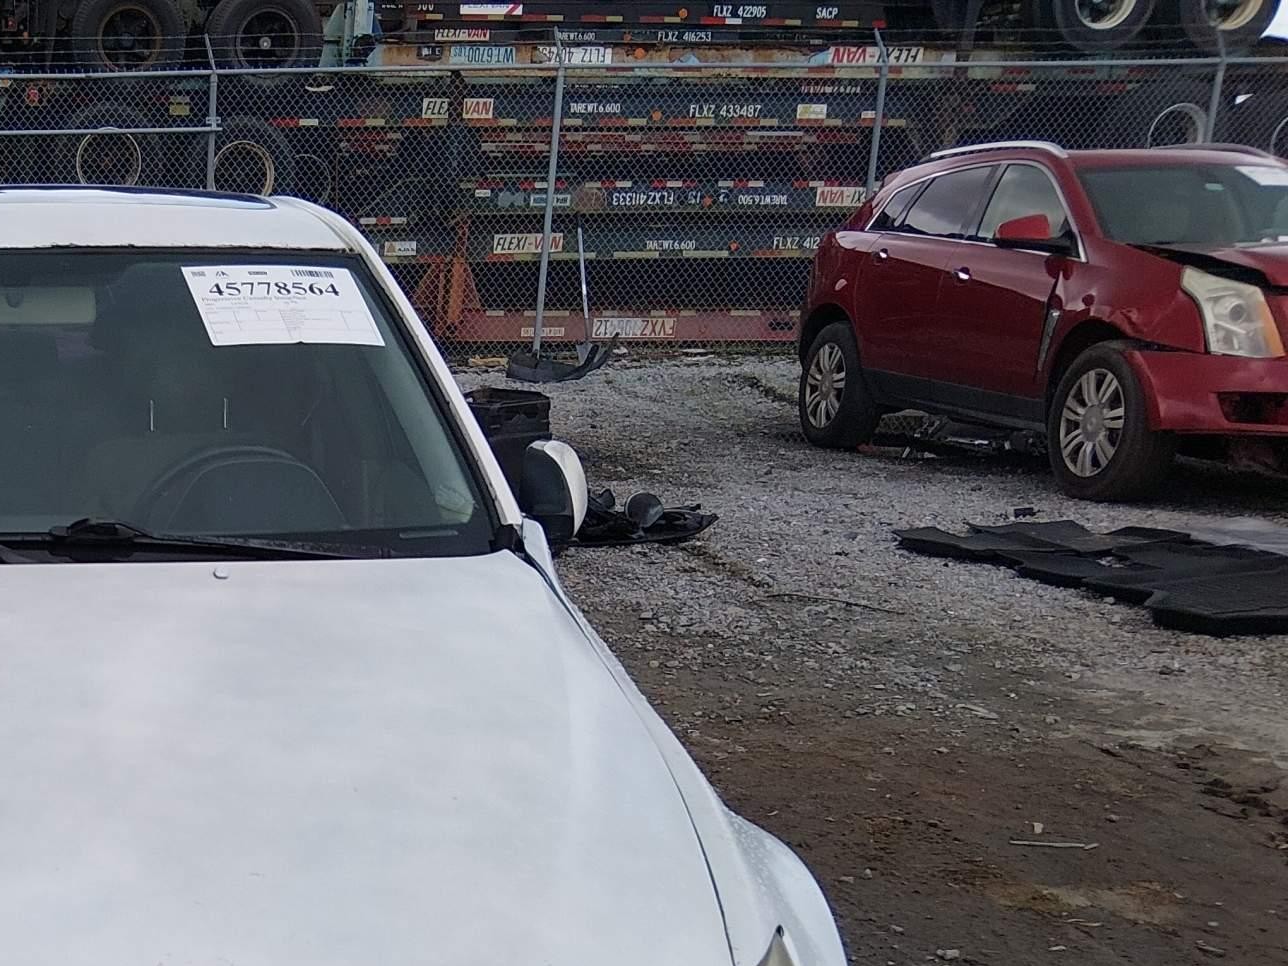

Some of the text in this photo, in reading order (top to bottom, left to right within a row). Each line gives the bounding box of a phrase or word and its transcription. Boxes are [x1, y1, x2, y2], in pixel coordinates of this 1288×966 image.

[713, 5, 767, 17] FLXZ 422905
[815, 7, 839, 19] SACP
[657, 31, 712, 42] FLXZ 416253
[463, 100, 493, 115] VAN
[689, 104, 762, 118] FLXZ 433487
[495, 236, 562, 251] FLEXI-VN
[773, 237, 799, 249] FLXZ
[208, 281, 340, 297] 45778564
